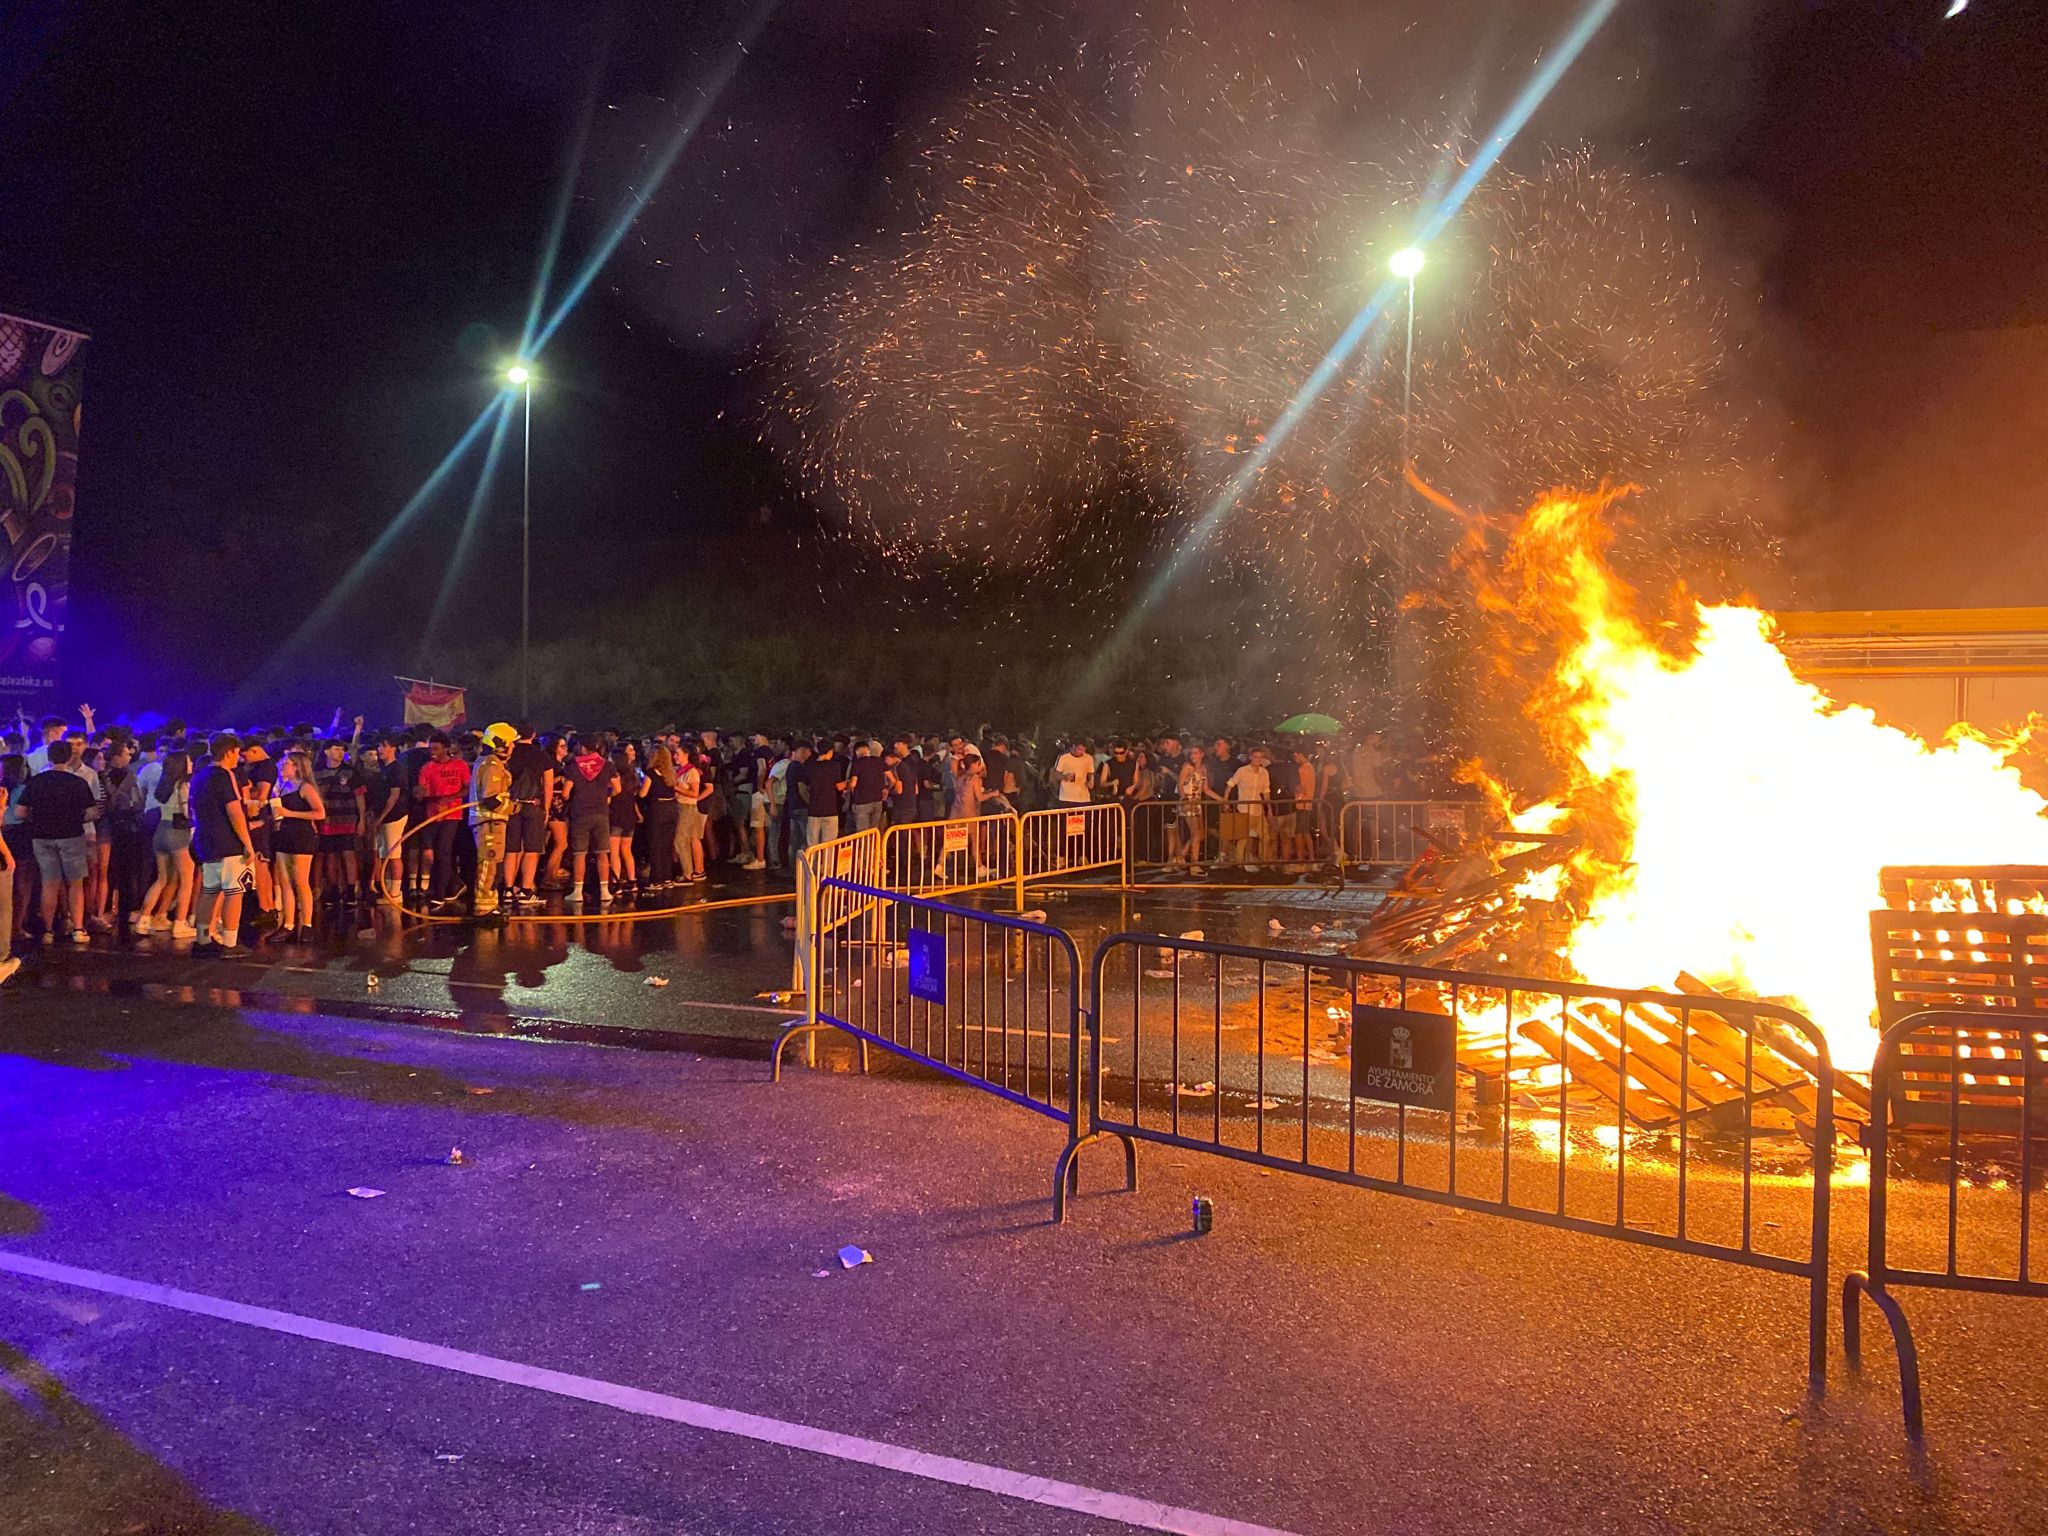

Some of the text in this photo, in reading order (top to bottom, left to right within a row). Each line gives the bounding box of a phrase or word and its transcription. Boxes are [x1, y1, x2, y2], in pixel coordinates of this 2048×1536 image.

[1368, 1066, 1434, 1084] AYUNTAMIENTO
[1368, 1074, 1434, 1096] DE ZAMORA
